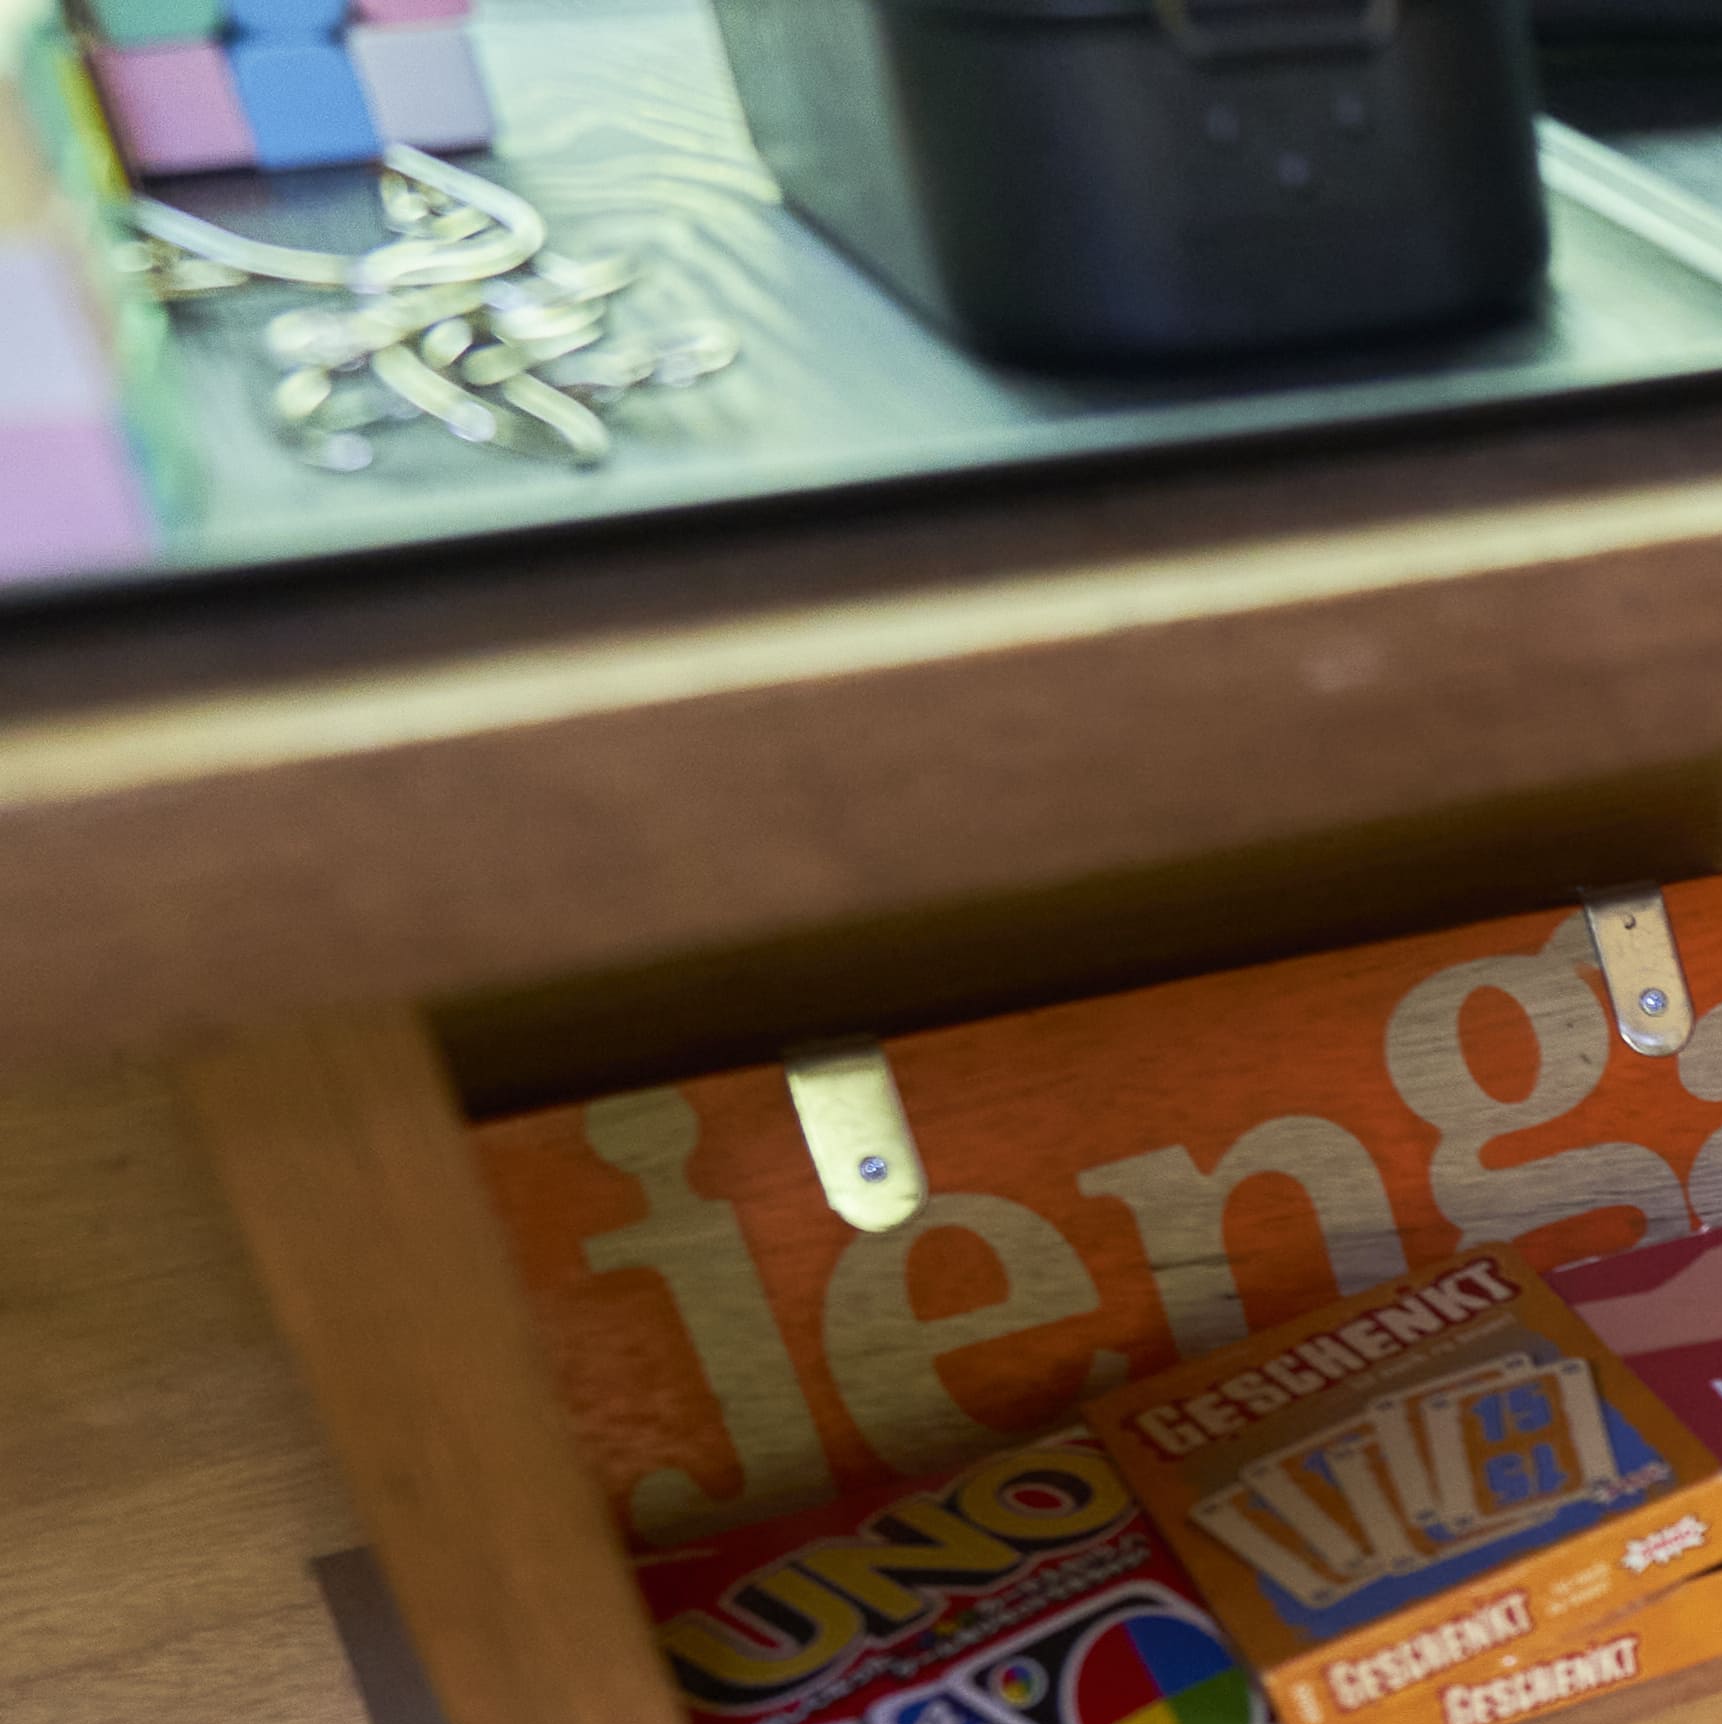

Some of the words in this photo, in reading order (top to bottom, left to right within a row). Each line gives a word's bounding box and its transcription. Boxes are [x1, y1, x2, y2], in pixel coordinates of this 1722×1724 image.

[1133, 1256, 1520, 1457] GESCHENKT
[1472, 1381, 1553, 1443] 15
[655, 1440, 1142, 1713] UNO
[1327, 1588, 1533, 1712] GESCHENKT
